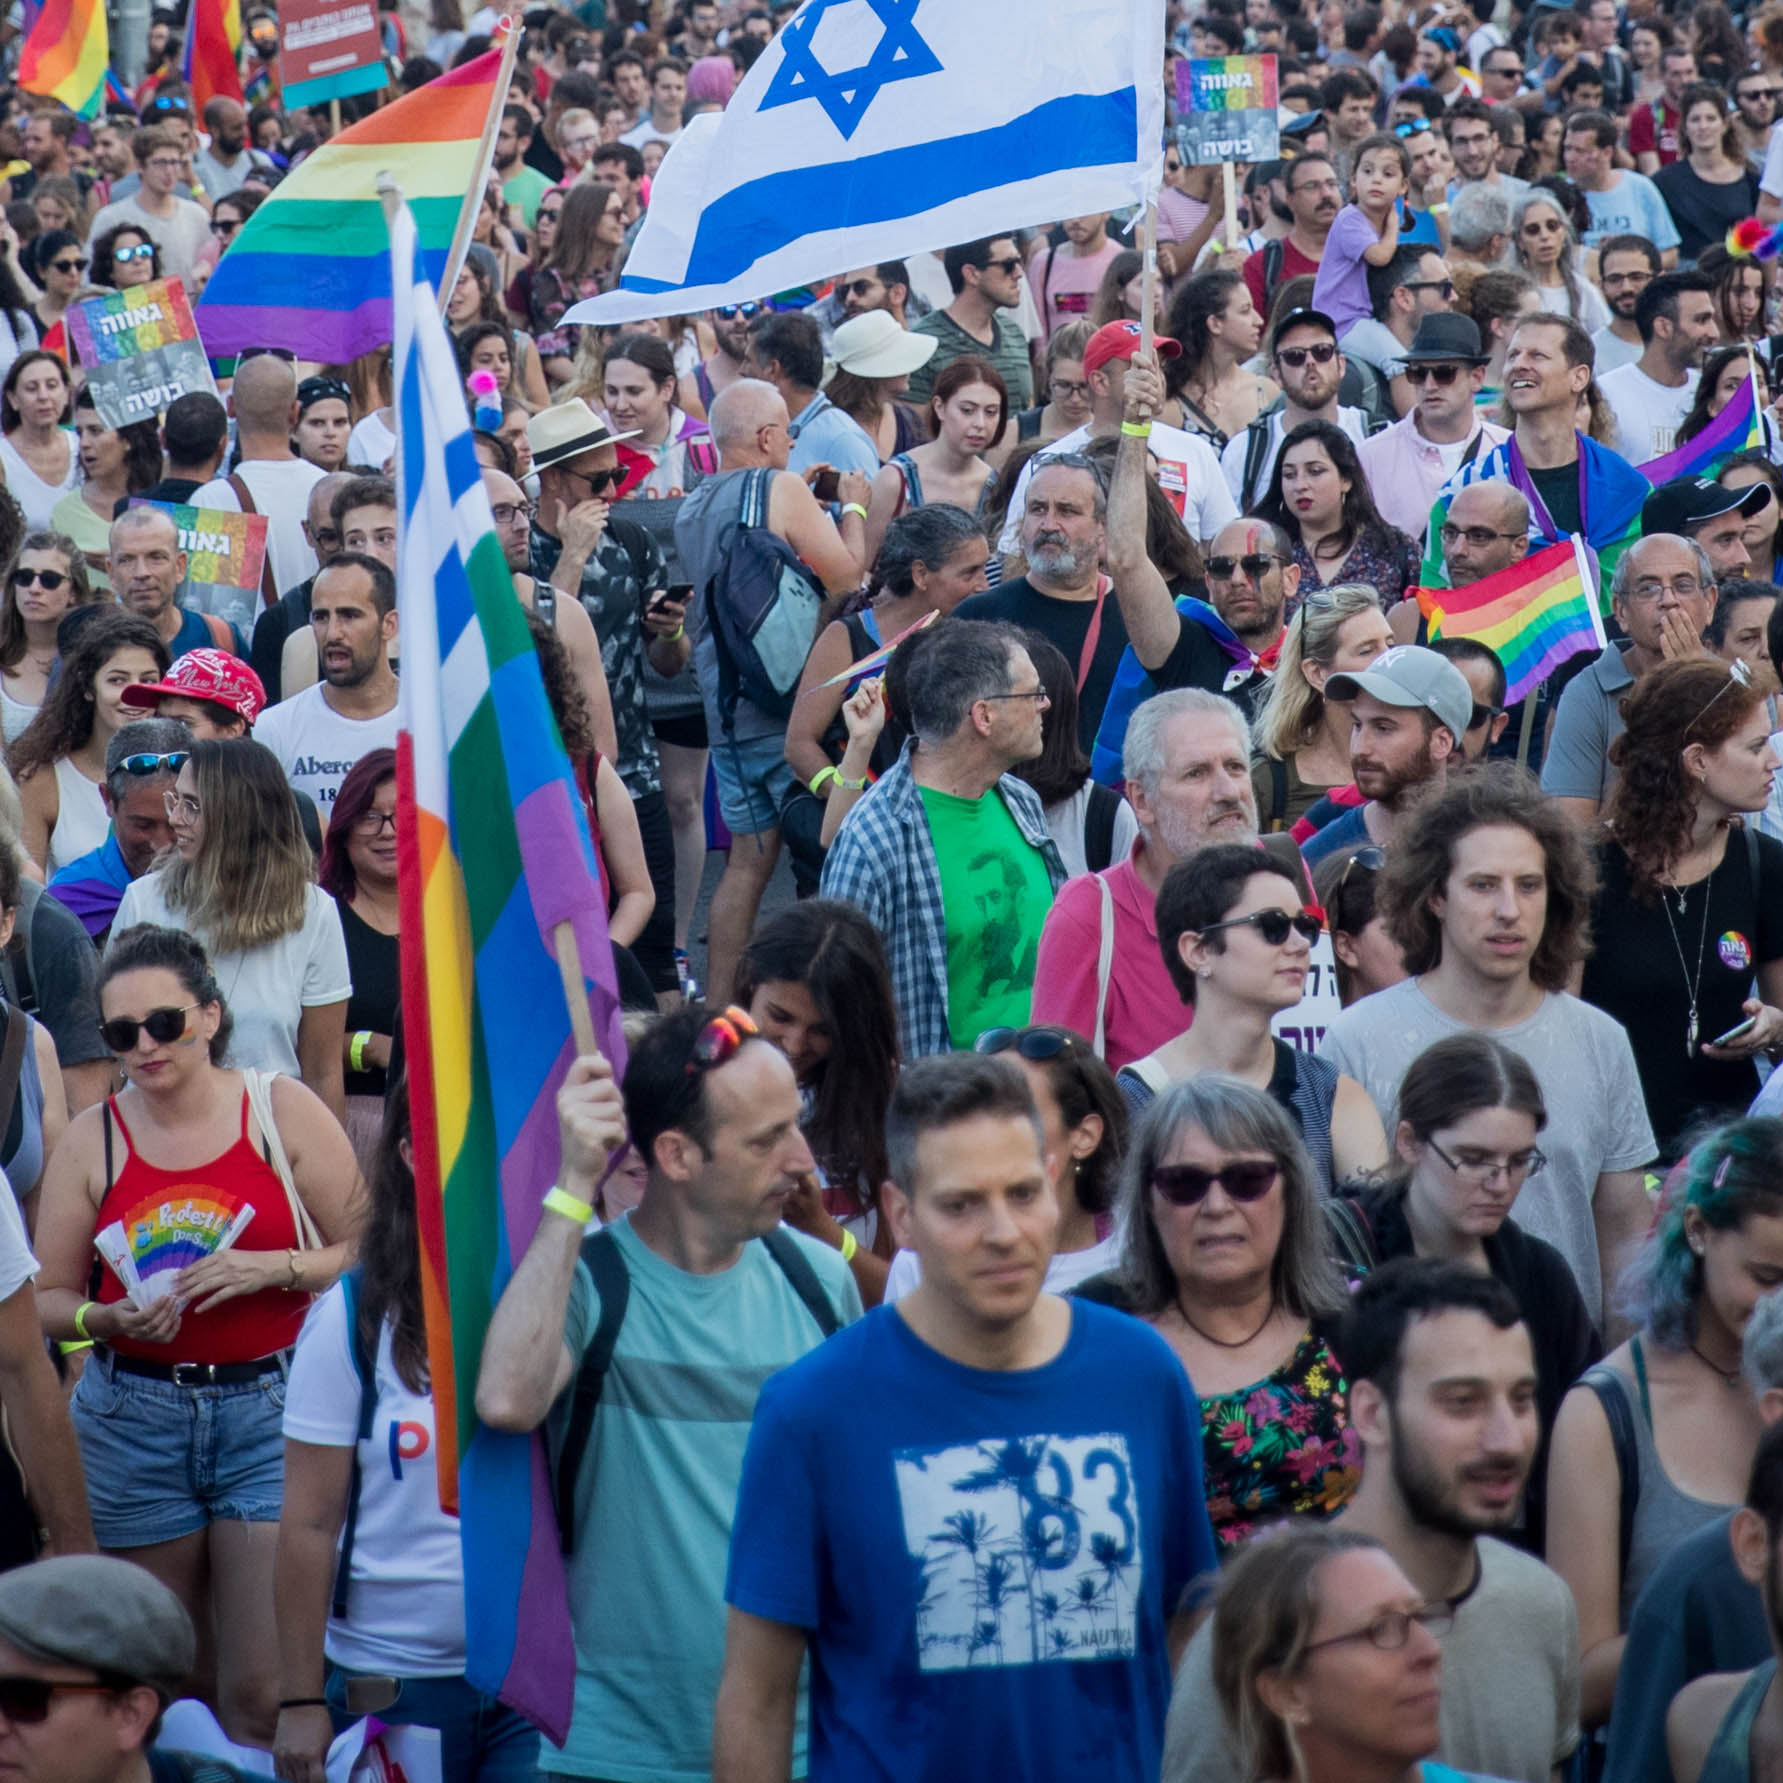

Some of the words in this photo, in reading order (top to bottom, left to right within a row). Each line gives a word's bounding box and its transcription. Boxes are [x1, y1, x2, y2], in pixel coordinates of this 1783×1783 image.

[1200, 72, 1254, 92] גאווה
[1203, 139, 1254, 158] בושה
[99, 302, 163, 335] גאווה
[125, 382, 187, 414] בושה
[178, 528, 232, 557] גאוו
[1721, 940, 1747, 955] גאה
[1025, 1446, 1137, 1571] 83
